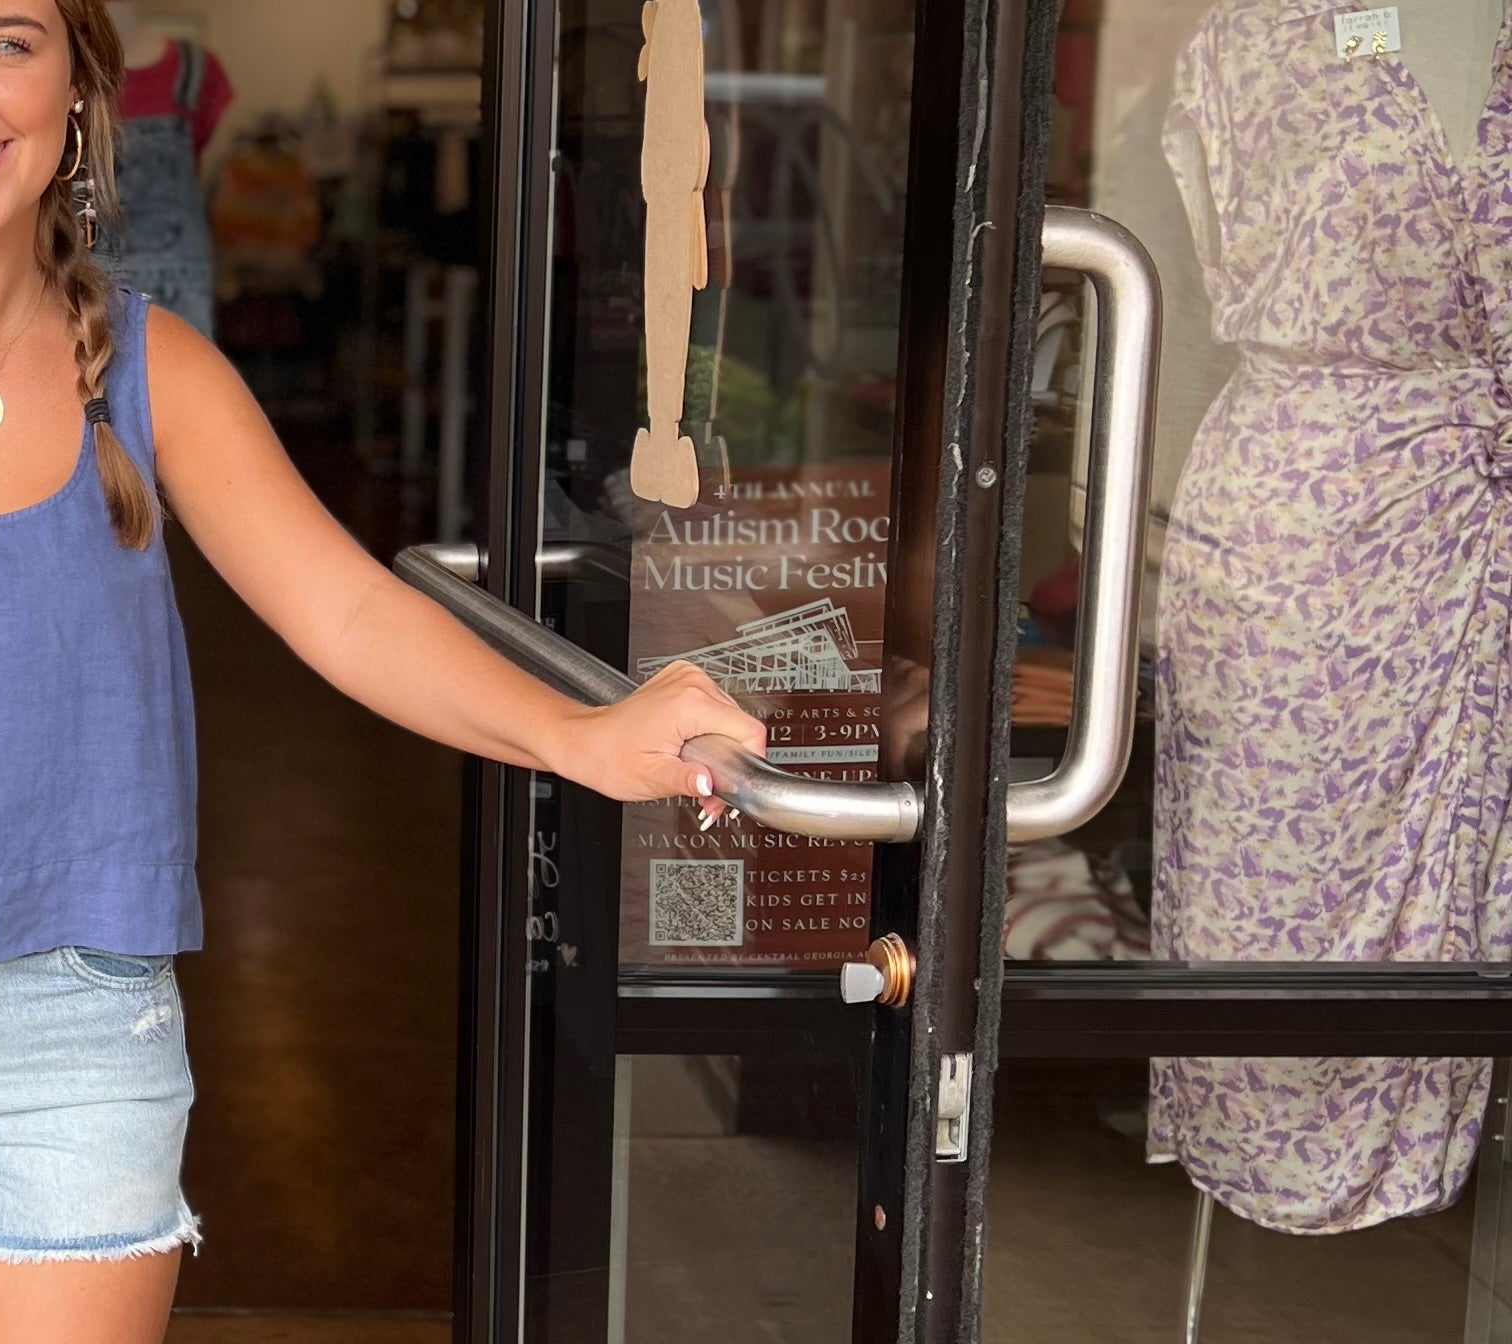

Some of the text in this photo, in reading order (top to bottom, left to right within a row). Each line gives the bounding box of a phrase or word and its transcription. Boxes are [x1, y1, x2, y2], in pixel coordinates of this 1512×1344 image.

[713, 479, 876, 499] 4TH ANNUAL
[646, 509, 800, 545] Autism
[644, 555, 769, 590] Music
[774, 709, 794, 719] OF
[800, 708, 839, 719] ARTS
[846, 708, 857, 718] &
[770, 725, 793, 742] 12
[638, 833, 721, 849] MACON
[730, 833, 800, 849] MUSIC
[746, 869, 867, 883] TICKETS $25
[746, 892, 867, 906] KIDS GET IN
[745, 916, 866, 931] ON SALE NO
[664, 953, 731, 962] PRESENTED
[733, 953, 744, 961] BY
[749, 952, 800, 961] CENTRAL
[804, 952, 853, 960] GEORGIA
